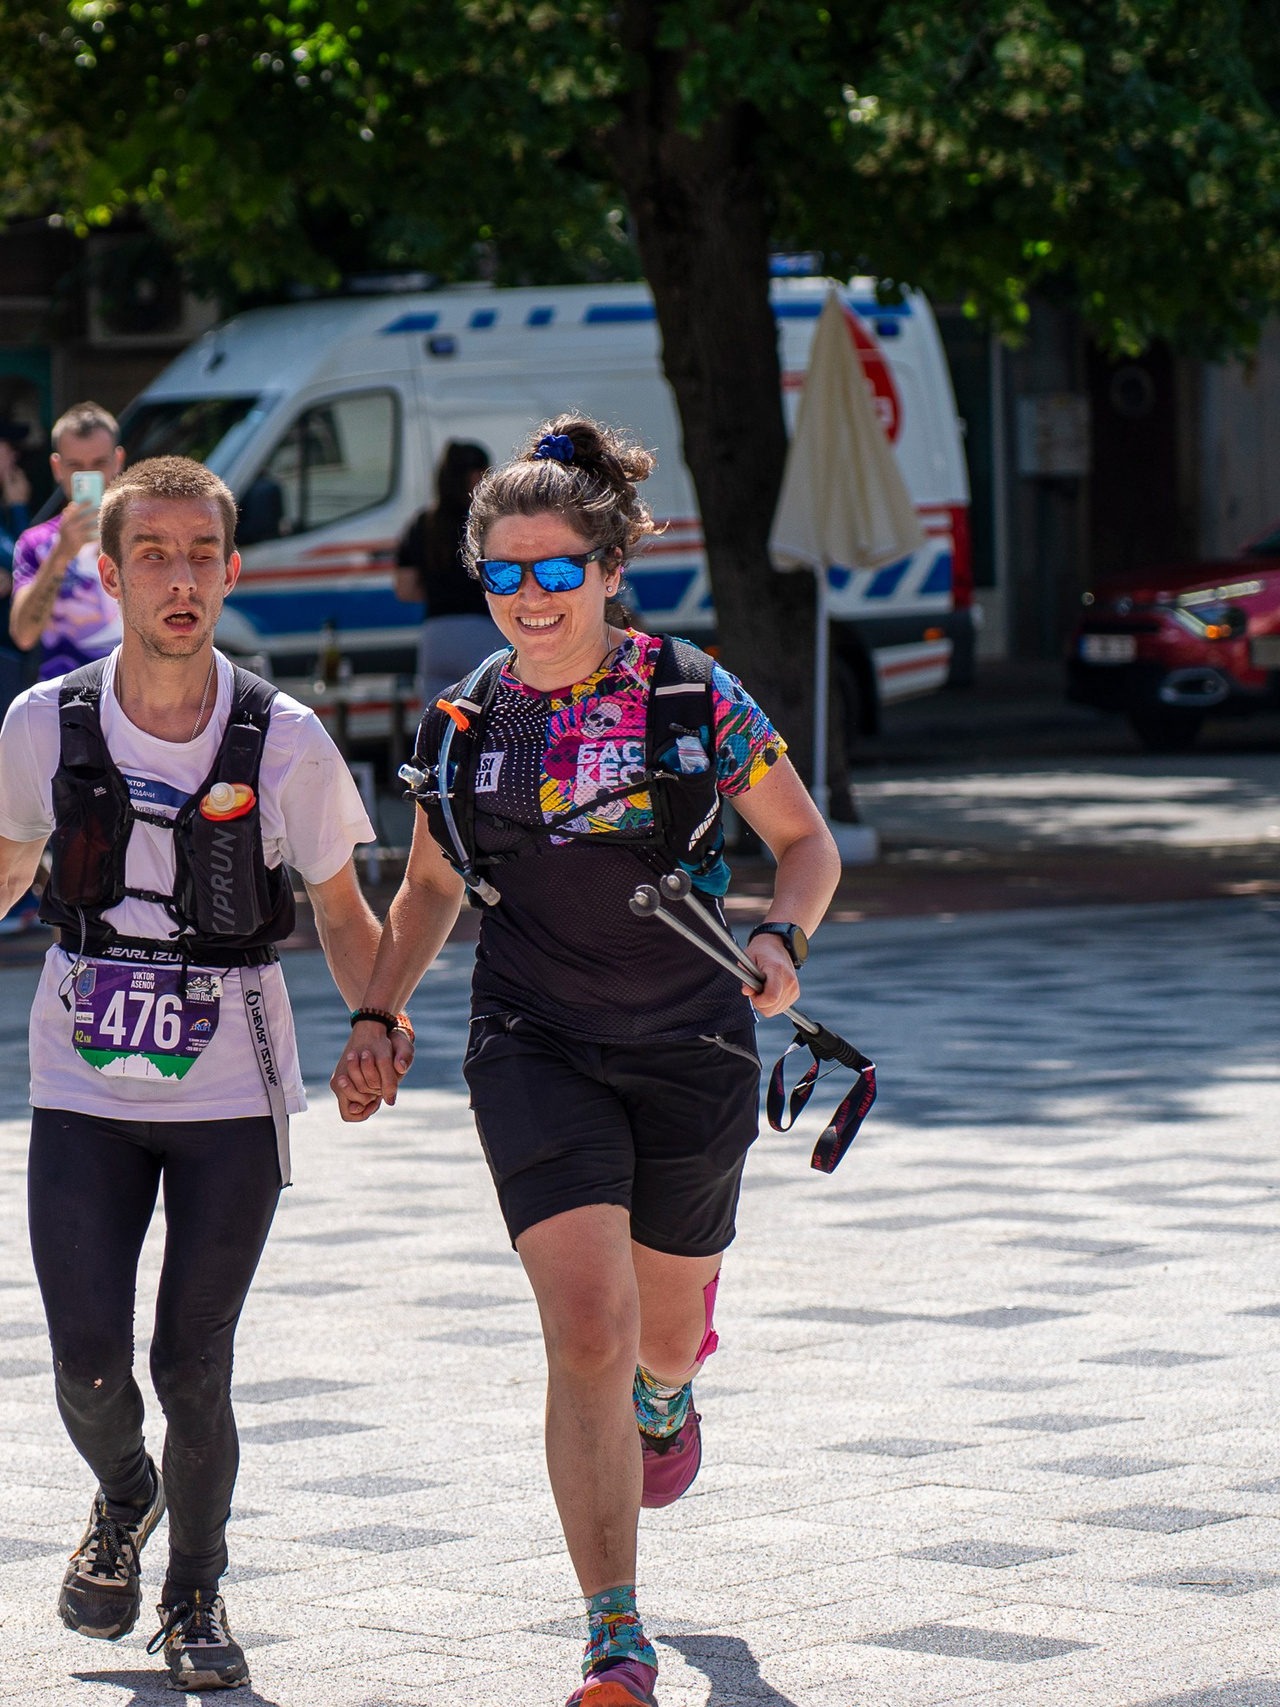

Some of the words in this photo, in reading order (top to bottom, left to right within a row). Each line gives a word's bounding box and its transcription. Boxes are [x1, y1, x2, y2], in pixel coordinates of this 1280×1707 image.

[133, 971, 155, 981] VIKTOR
[130, 980, 156, 990] ASENOV
[99, 990, 183, 1050] 476
